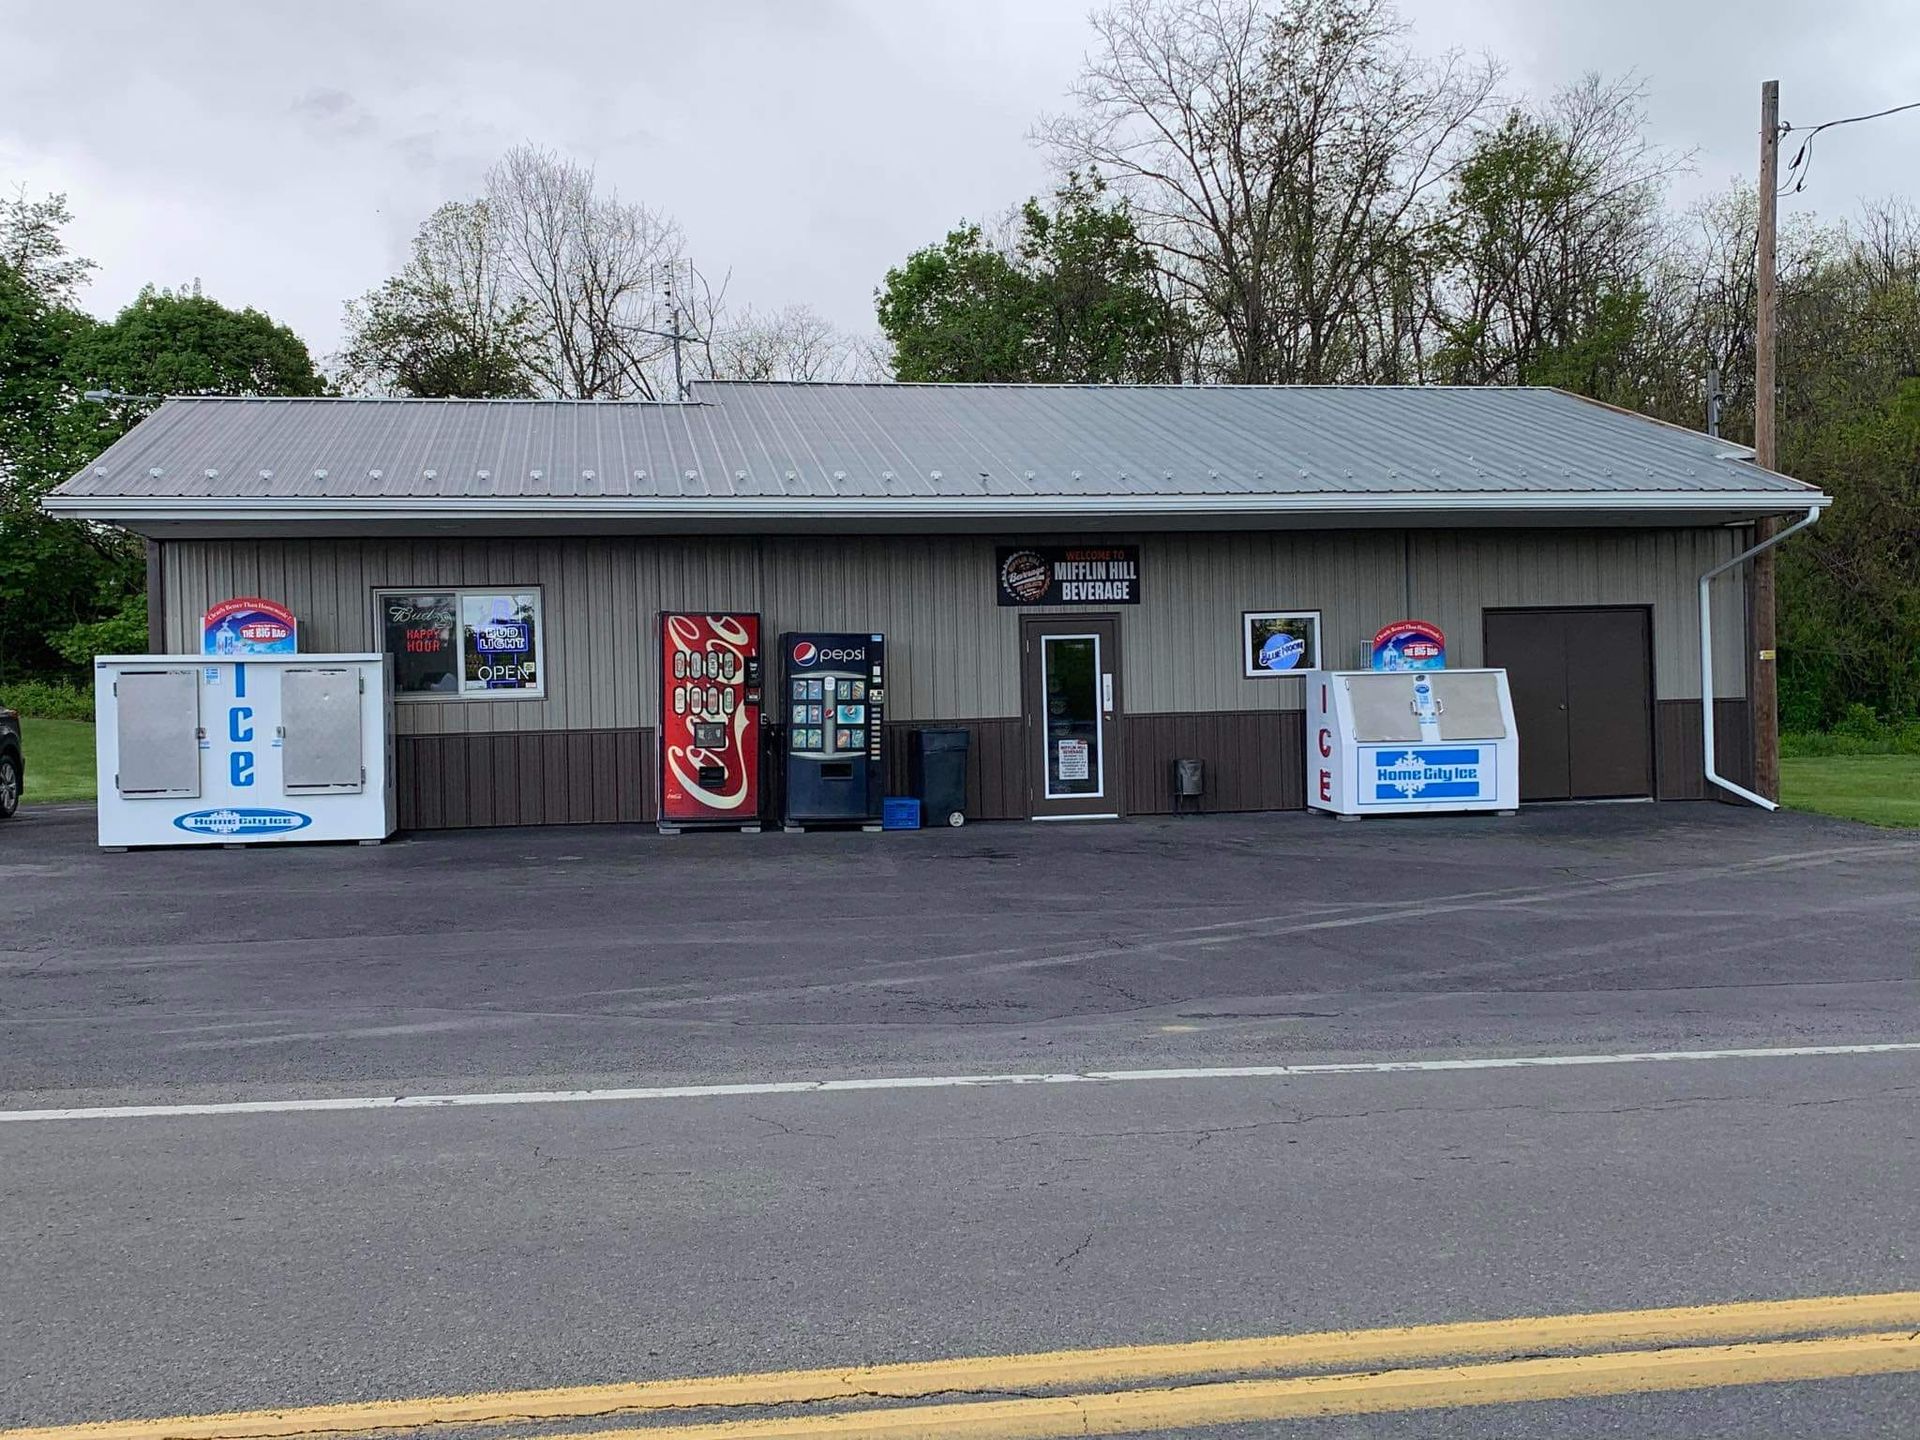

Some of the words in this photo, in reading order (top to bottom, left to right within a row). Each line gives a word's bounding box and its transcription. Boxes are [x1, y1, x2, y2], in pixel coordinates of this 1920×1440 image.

[1066, 550, 1110, 560] WELCOME
[1113, 550, 1125, 560] TO
[1054, 561, 1106, 580] MIFFLIN
[1109, 561, 1137, 579] HILL
[1062, 581, 1130, 600] BEVERAGE
[242, 629, 255, 638] THE
[255, 628, 271, 638] BIG
[271, 629, 287, 638] BAG
[406, 629, 441, 640] HAPPY
[485, 627, 519, 638] BUD
[406, 640, 441, 652] HOUR
[479, 637, 525, 650] LIGHT
[819, 646, 865, 663] pepsi
[477, 665, 530, 681] OPEN
[1319, 684, 1332, 802] ICE
[1377, 768, 1422, 781] Home
[1424, 767, 1453, 782] City
[1455, 767, 1478, 779] Ice
[194, 817, 237, 826] Home
[239, 817, 268, 827] City
[269, 817, 292, 825] Ice
